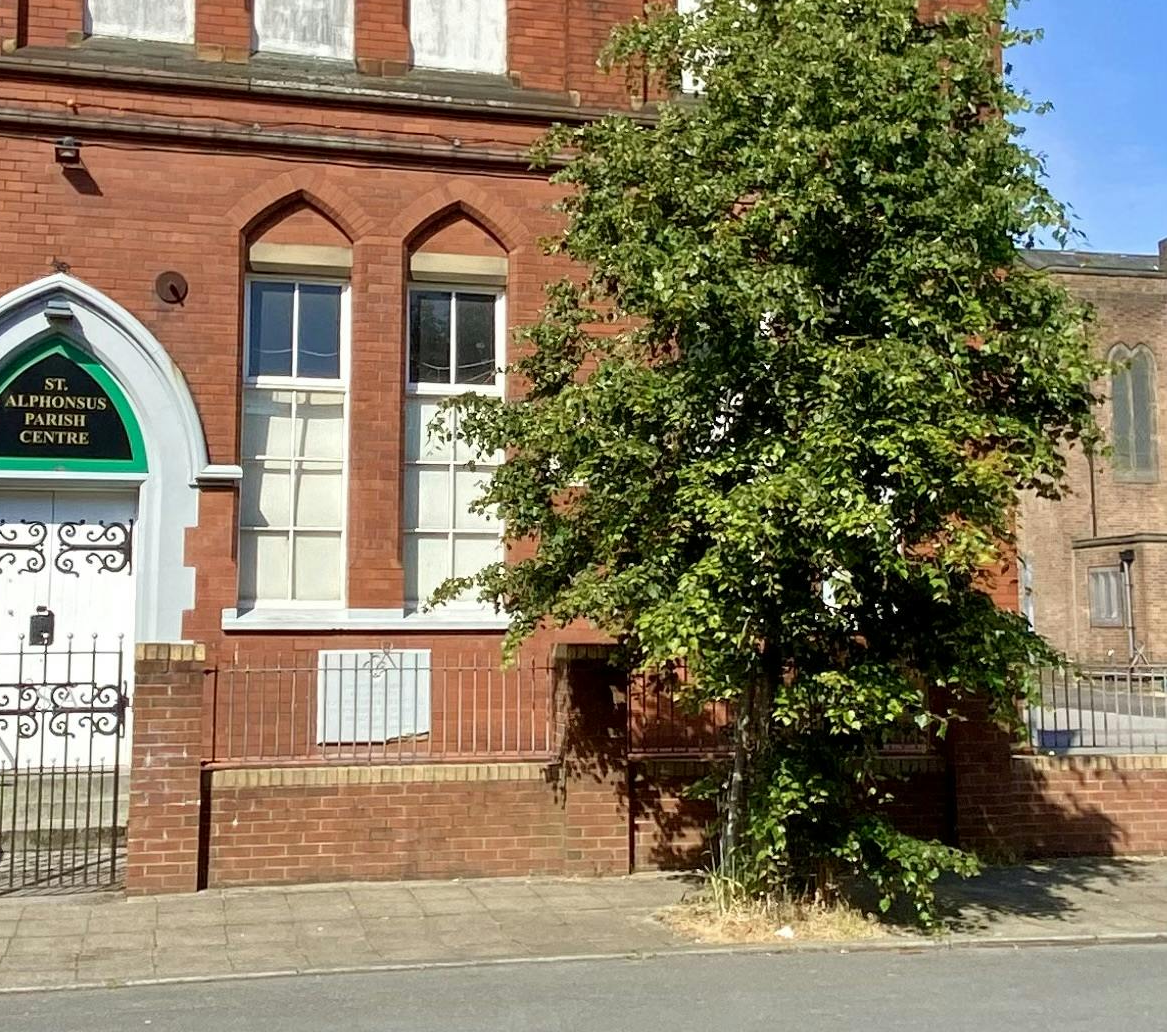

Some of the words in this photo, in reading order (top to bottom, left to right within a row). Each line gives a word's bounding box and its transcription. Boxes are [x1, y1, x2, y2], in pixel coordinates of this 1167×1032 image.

[45, 378, 68, 391] ST.
[5, 395, 106, 410] ALPHONSUS
[24, 412, 86, 427] PARISH
[19, 430, 89, 445] CENTRE
